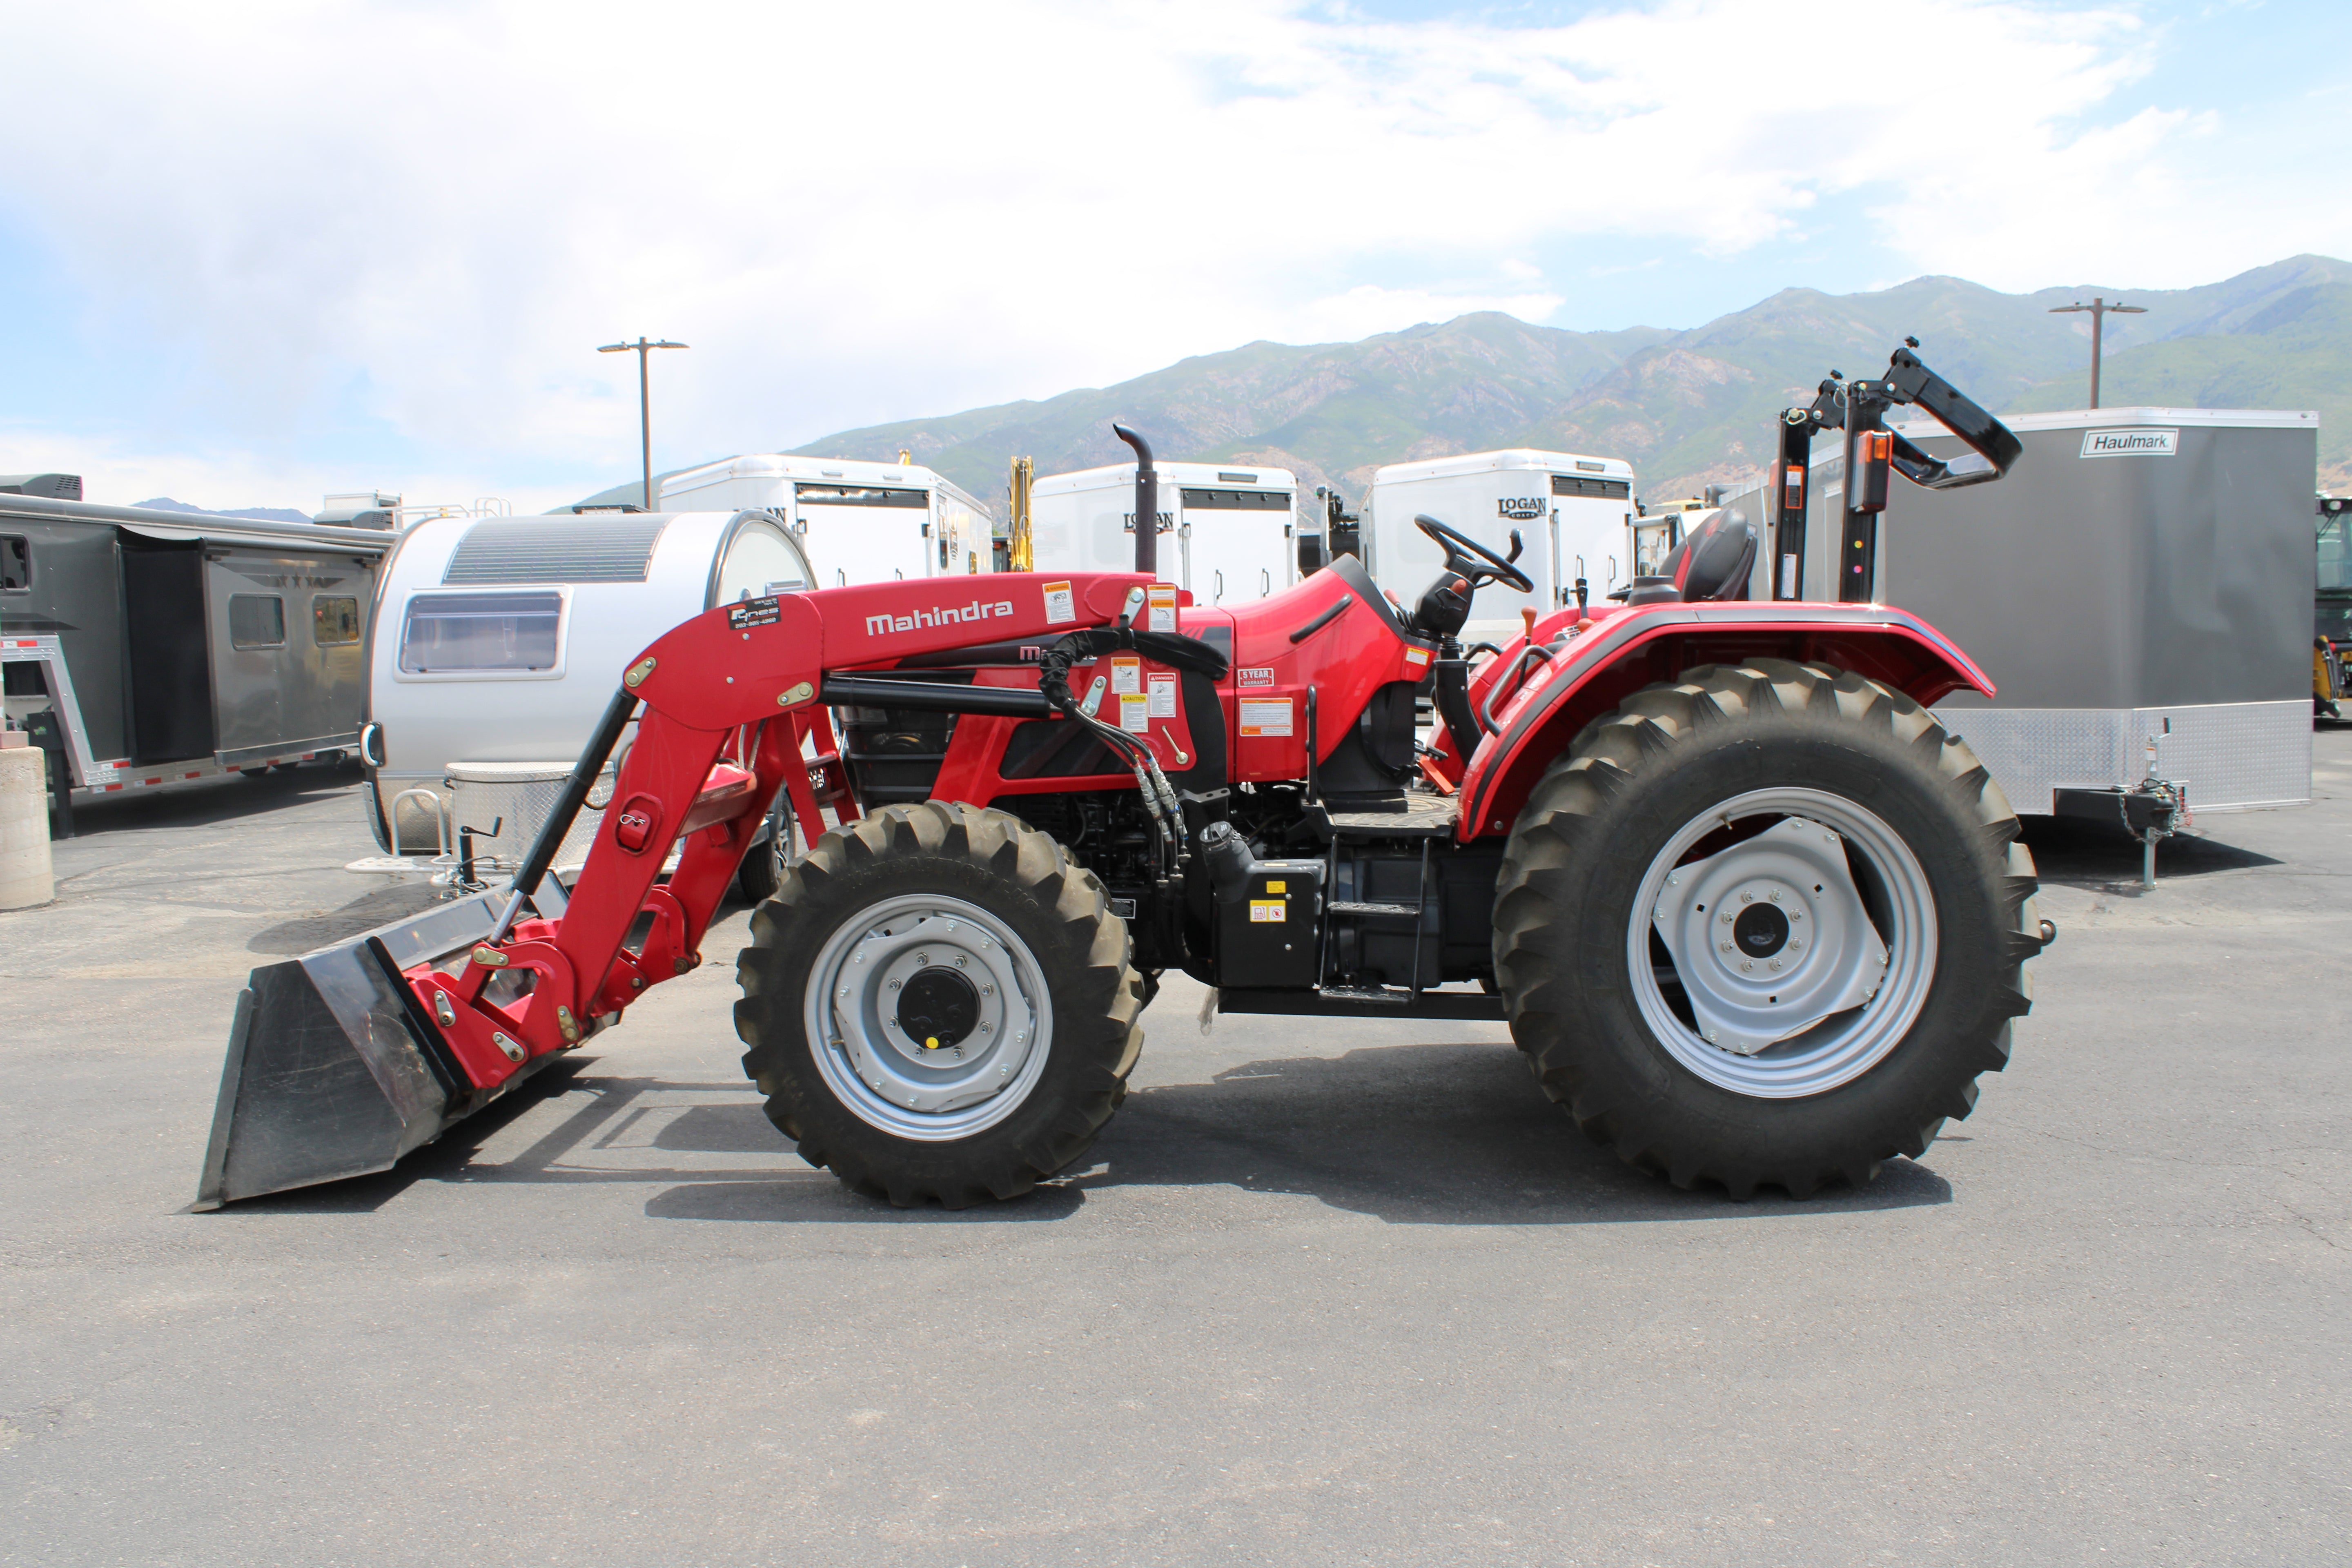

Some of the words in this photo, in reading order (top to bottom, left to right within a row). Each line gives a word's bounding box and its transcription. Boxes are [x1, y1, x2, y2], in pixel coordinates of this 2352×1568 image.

[2094, 434, 2167, 450] Haulmark
[1498, 498, 1546, 516] LOGAN
[1123, 512, 1174, 530] LAN
[731, 607, 779, 621] Pynes
[1249, 670, 1269, 678] YEAR
